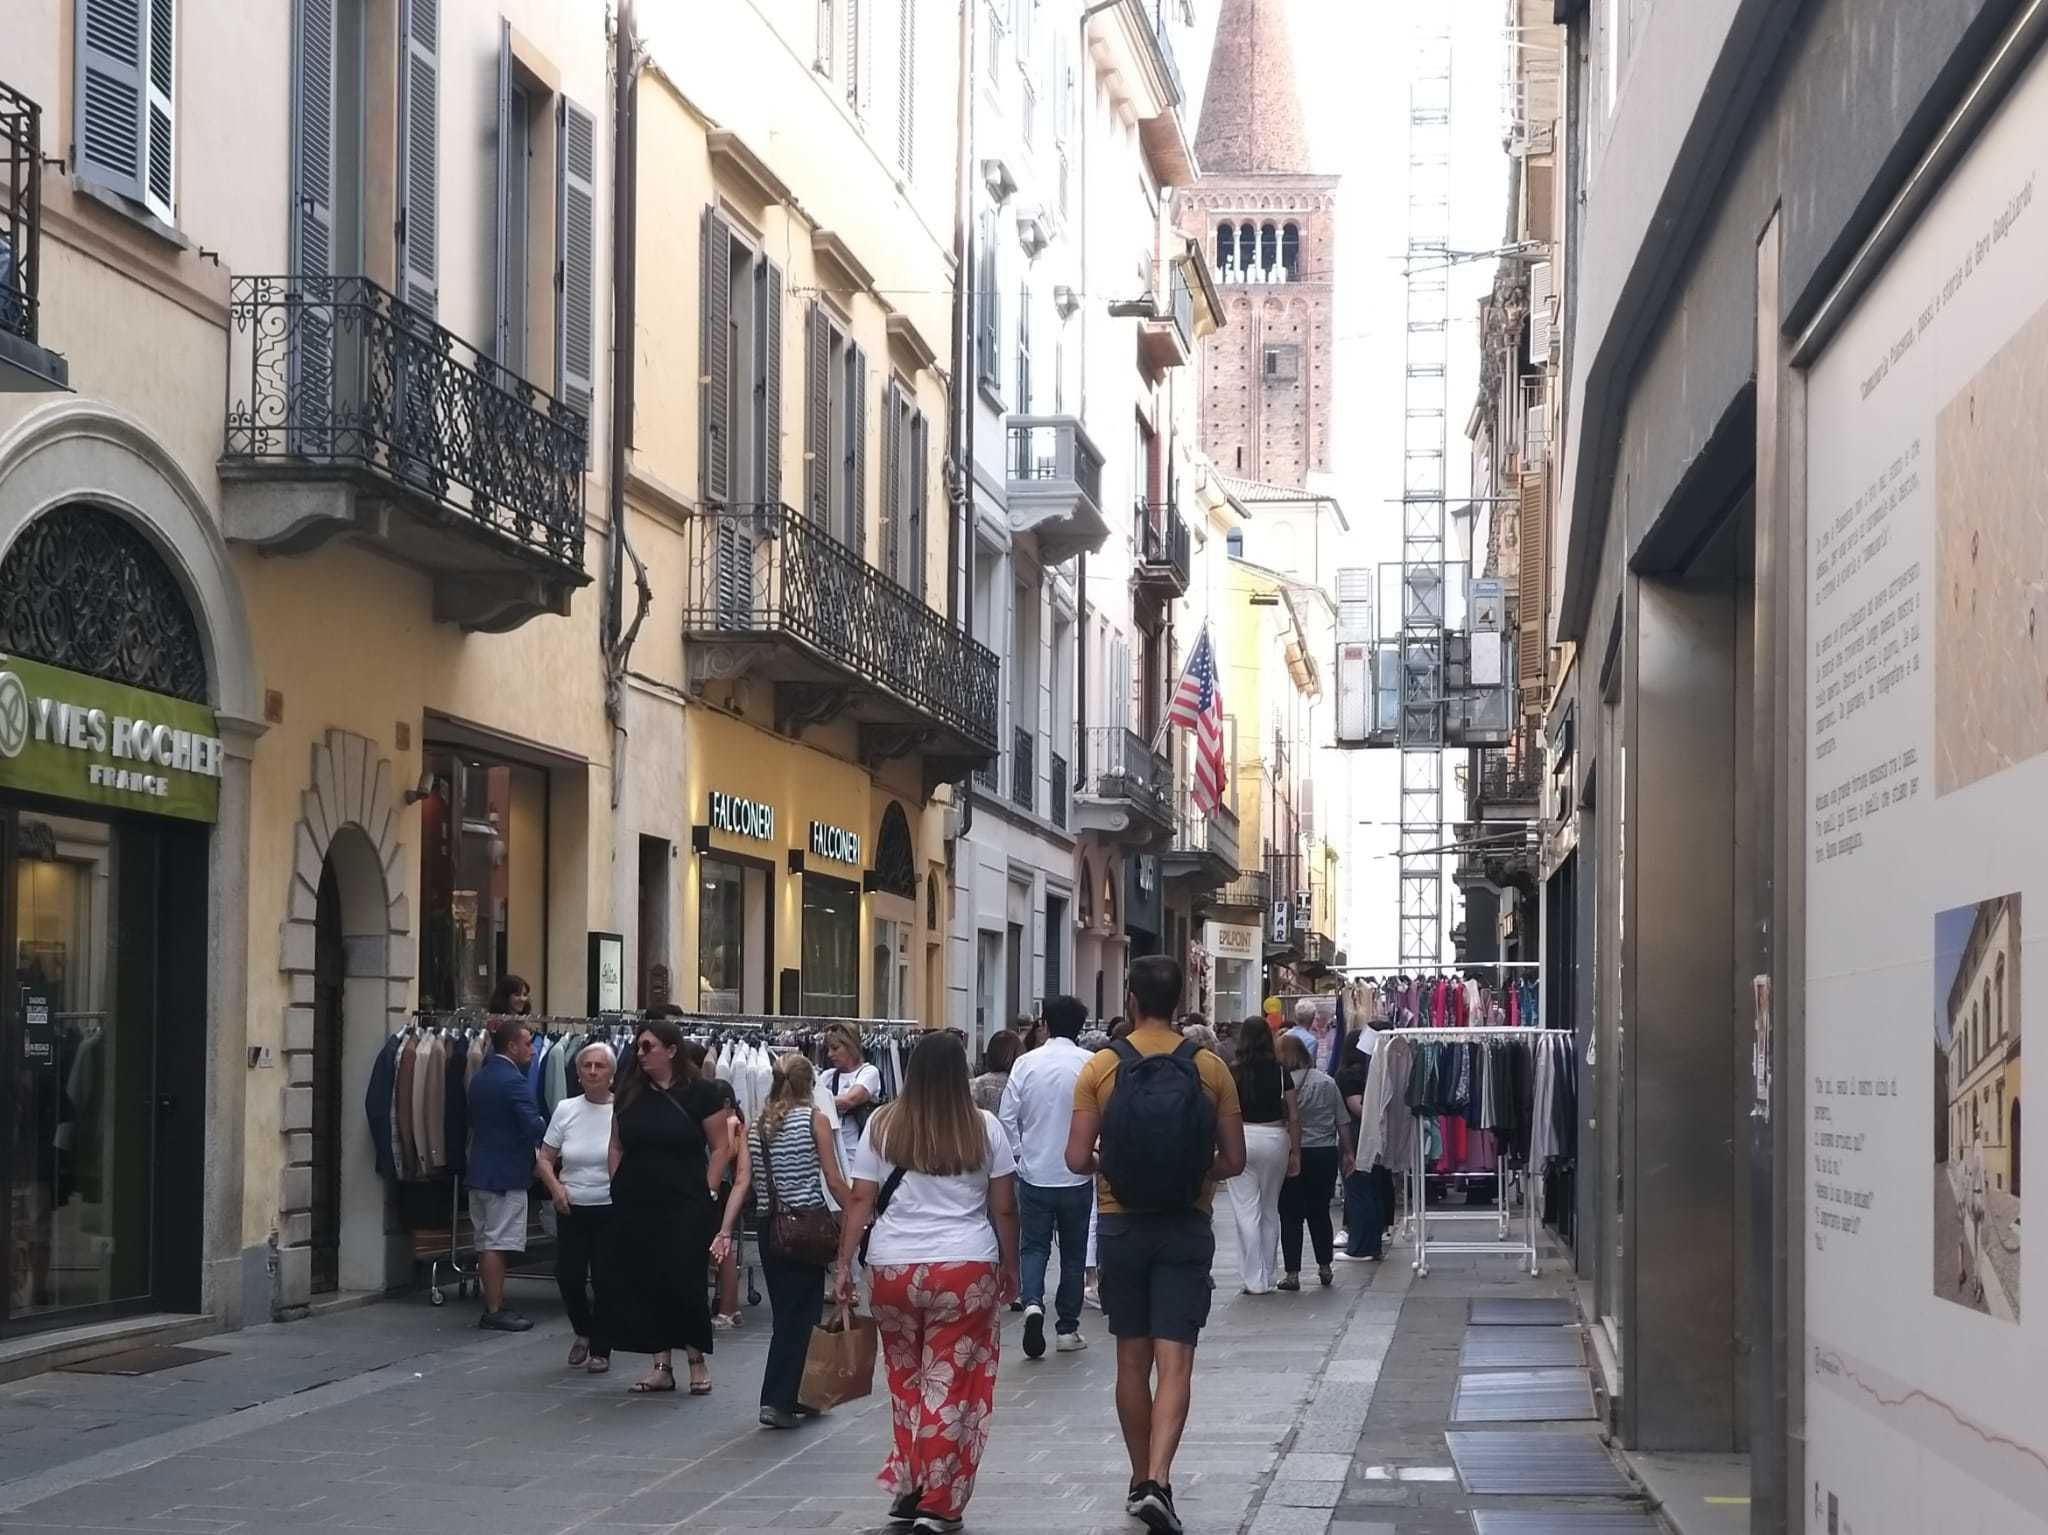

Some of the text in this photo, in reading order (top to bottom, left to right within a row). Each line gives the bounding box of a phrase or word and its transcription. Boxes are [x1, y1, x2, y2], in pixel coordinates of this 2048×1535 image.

[31, 696, 225, 777] YVES ROCHER
[89, 764, 169, 797] FRANCE
[713, 791, 775, 841] FALCONERI
[813, 821, 862, 865] FALCONERI
[1219, 929, 1252, 947] EPILPOINT
[1276, 903, 1285, 940] BAR
